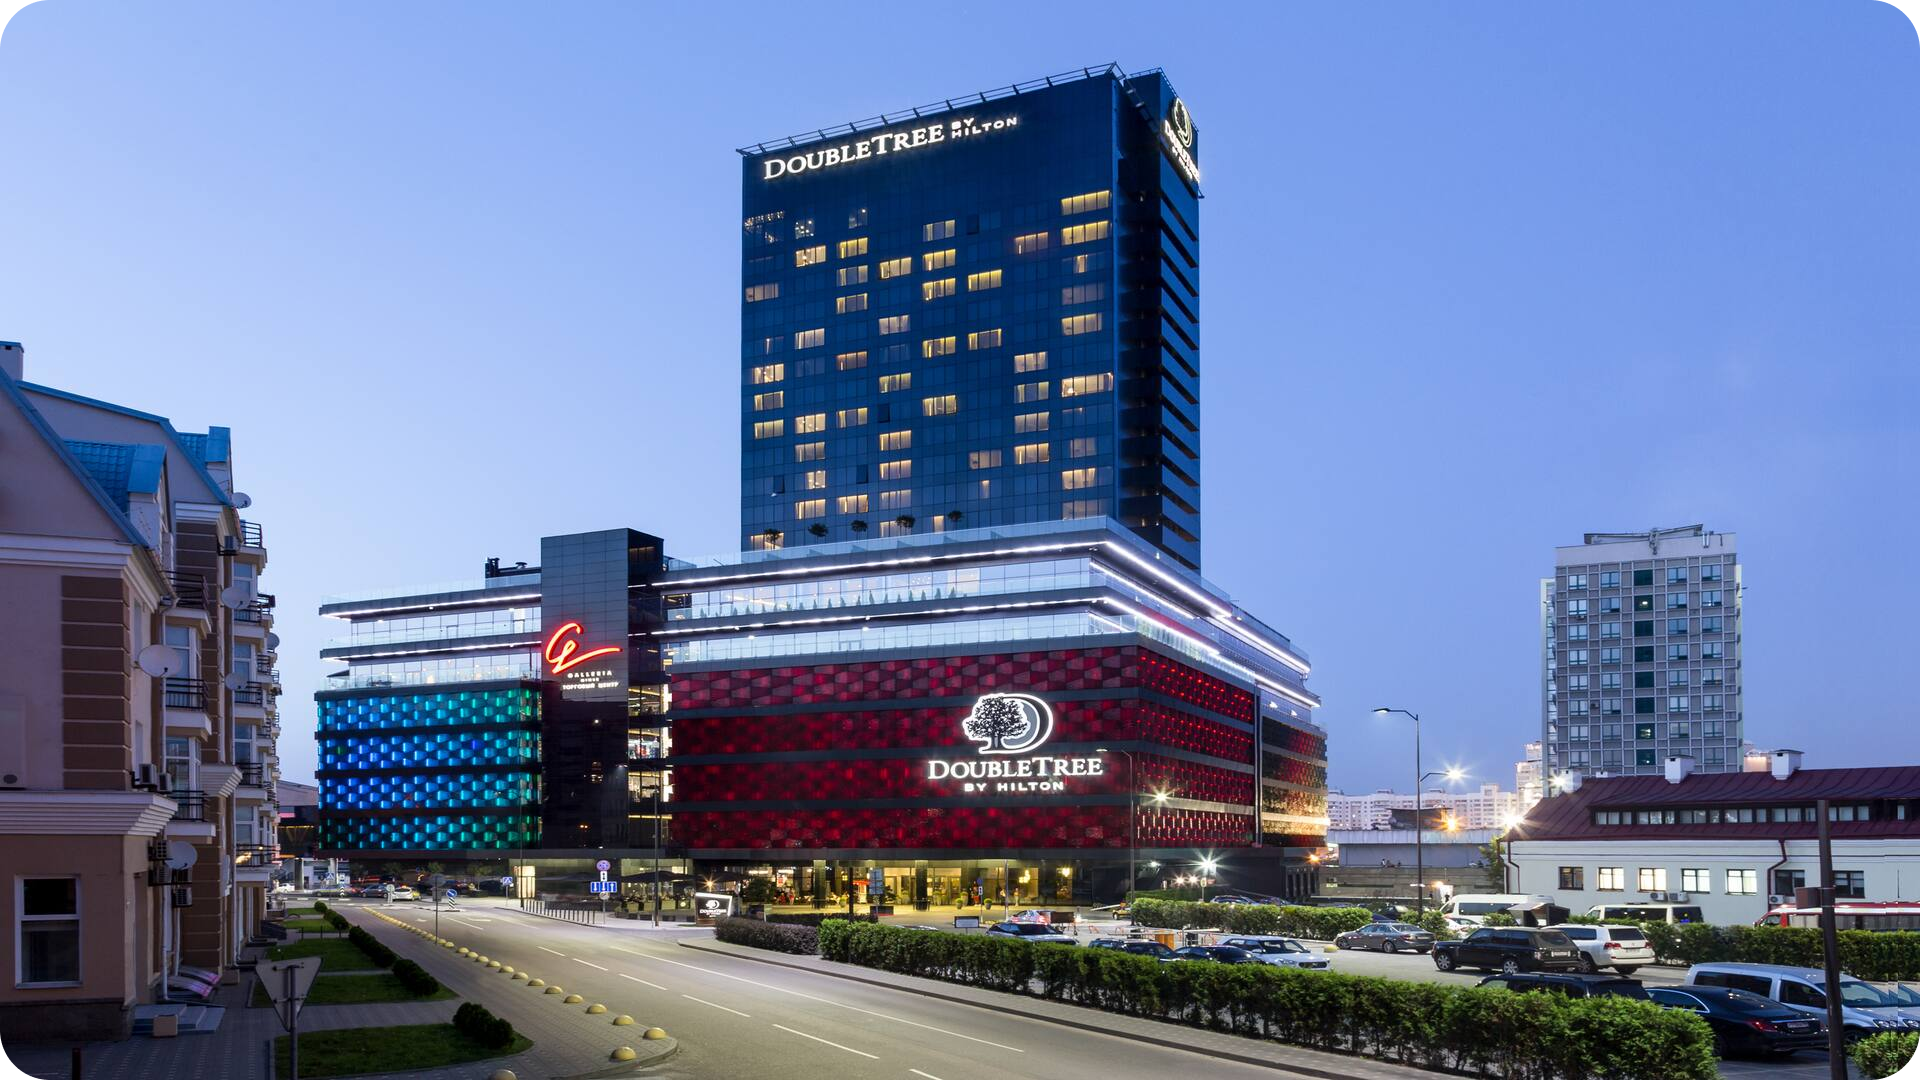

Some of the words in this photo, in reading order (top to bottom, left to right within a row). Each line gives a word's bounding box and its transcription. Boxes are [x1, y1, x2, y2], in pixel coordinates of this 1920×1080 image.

[951, 117, 1018, 139] HILTON
[764, 124, 944, 180] DOUBLETREE
[951, 117, 975, 131] BY
[927, 757, 1104, 780] DOUBLETREE
[964, 782, 987, 792] BY
[996, 781, 1065, 792] HILTON
